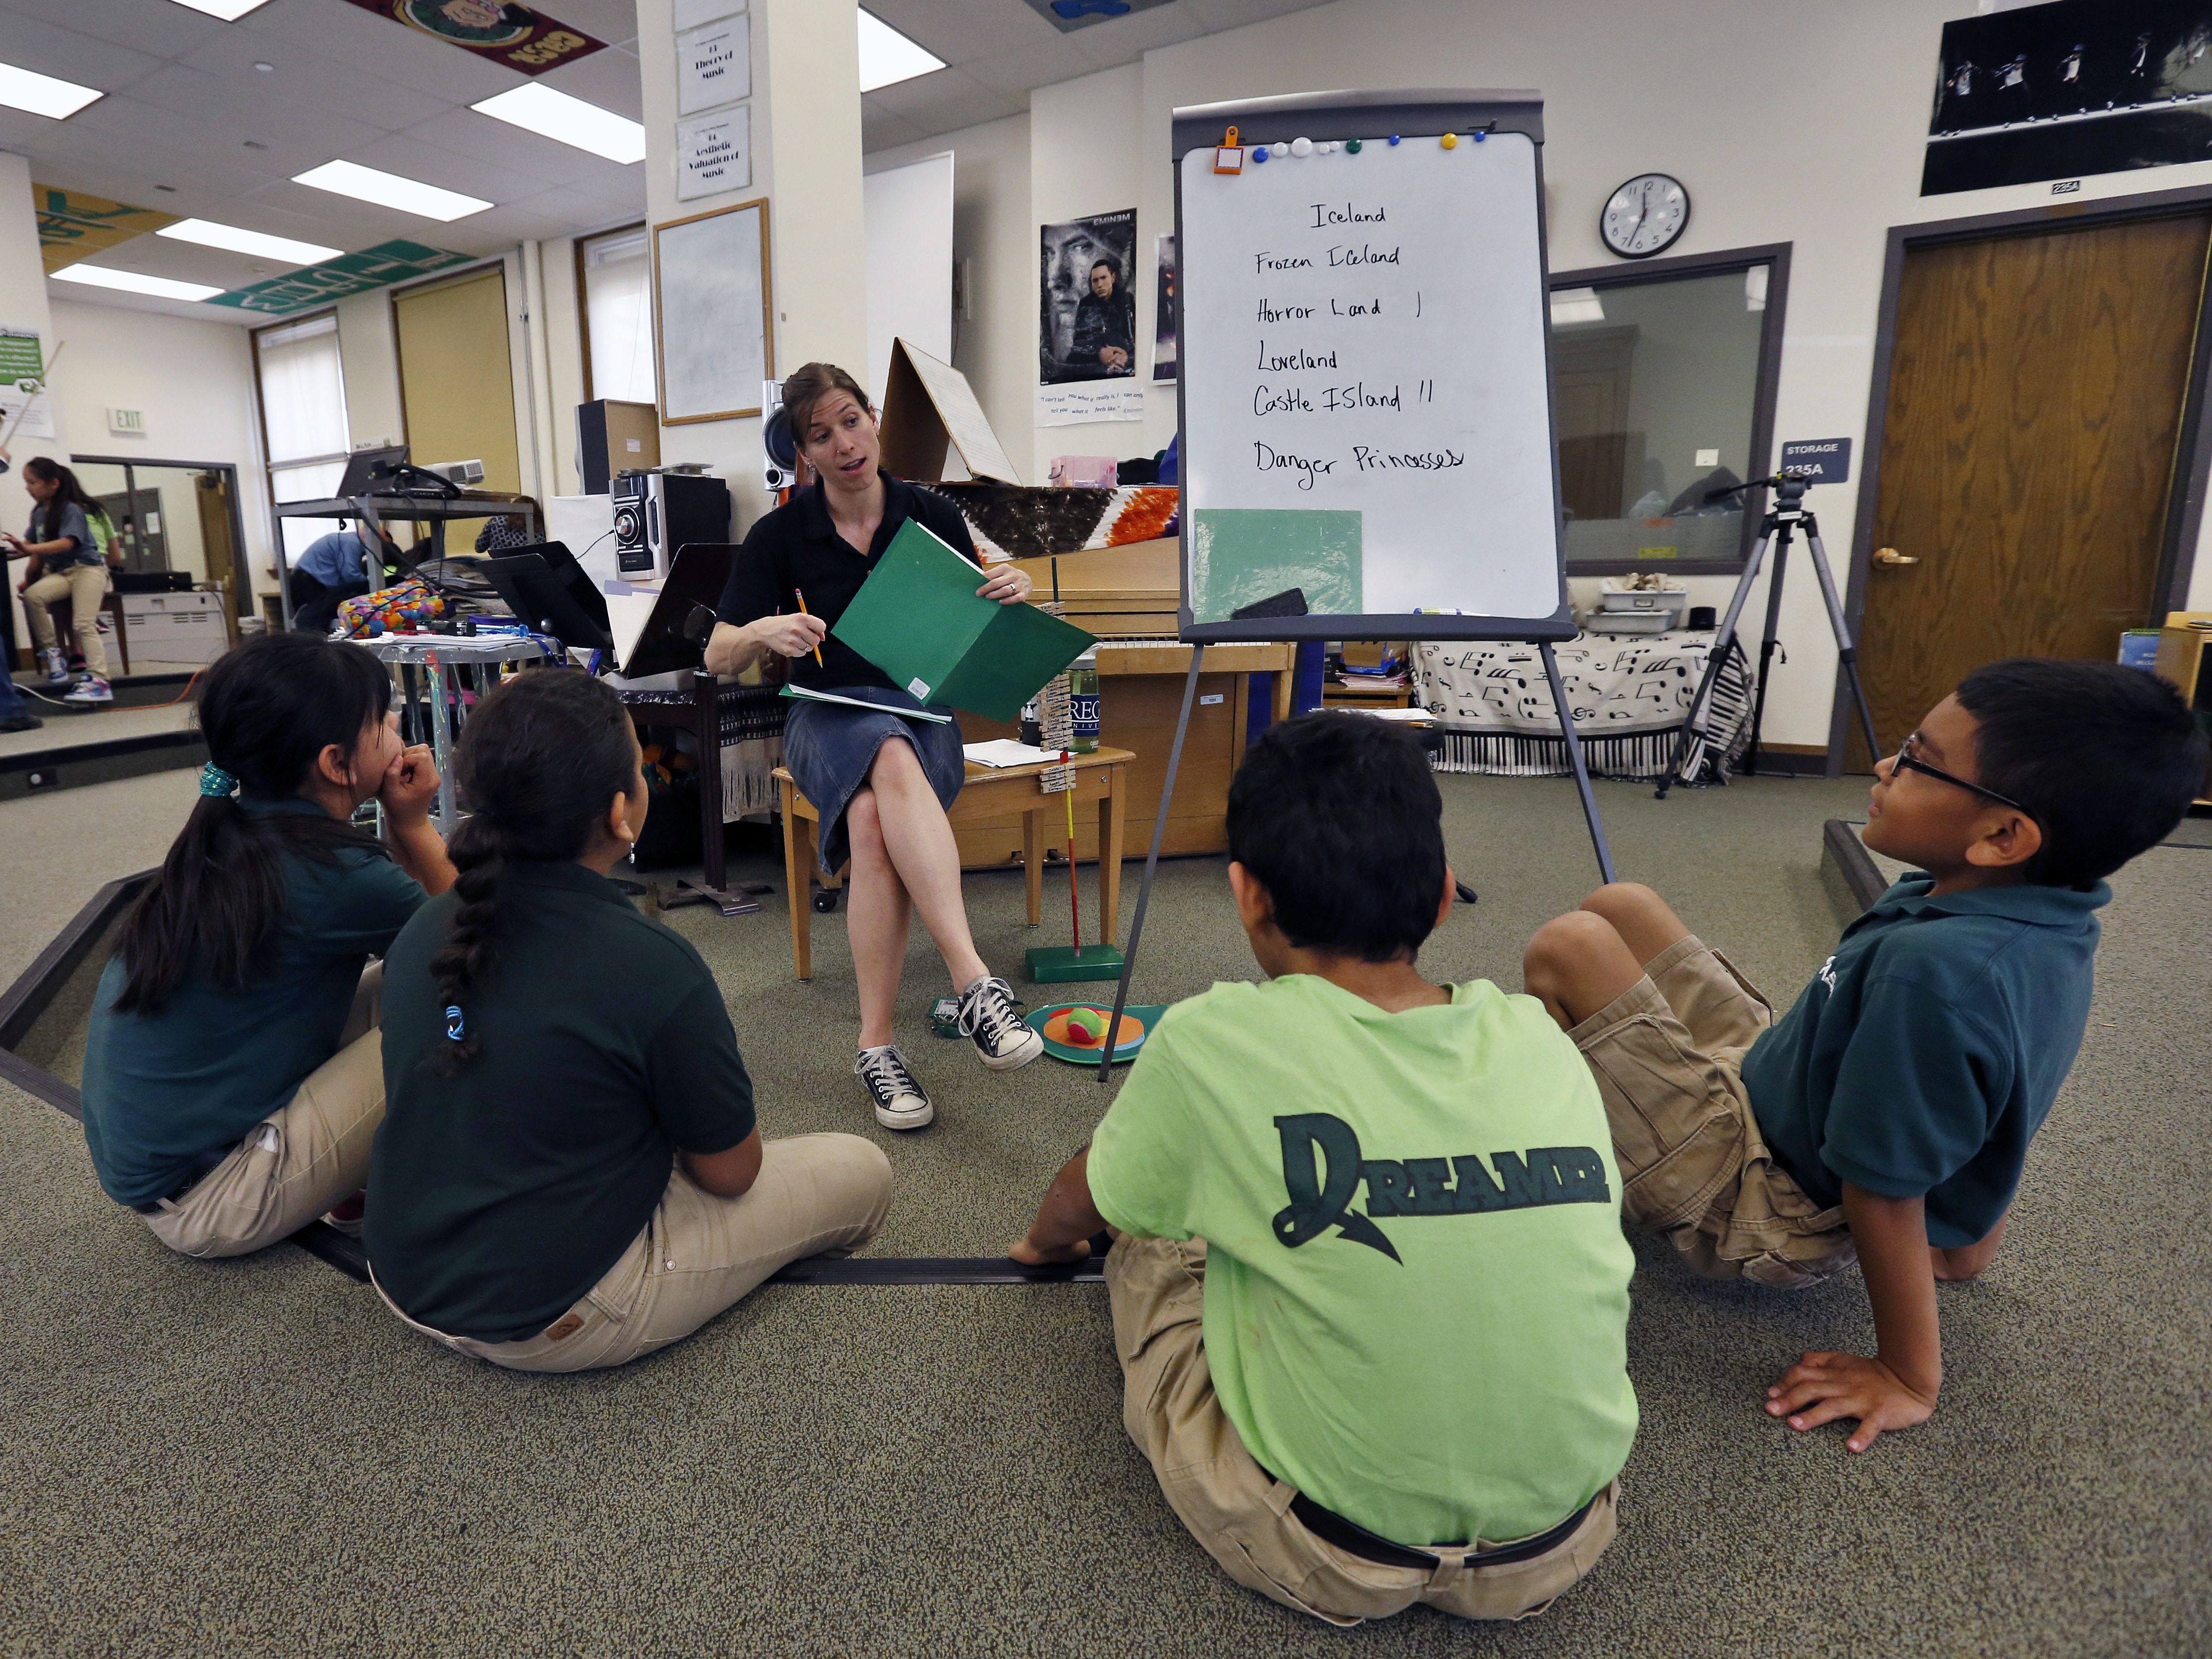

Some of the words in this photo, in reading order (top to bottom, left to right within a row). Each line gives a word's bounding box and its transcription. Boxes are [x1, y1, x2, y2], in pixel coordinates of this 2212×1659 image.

[696, 56, 722, 70] Theory
[724, 50, 732, 60] of
[702, 66, 725, 79] Music
[696, 141, 730, 156] Aesthetic
[689, 155, 729, 170] Valuation
[731, 150, 738, 160] of
[702, 166, 724, 179] Music
[1645, 181, 1654, 190] 12
[2052, 182, 2080, 193] 235A
[1670, 194, 1677, 203] 2
[1311, 203, 1386, 228] Iceland
[1673, 208, 1679, 217] 3
[1622, 237, 1628, 246] 7
[1653, 235, 1659, 244] 5
[1255, 252, 1313, 274] Frozen
[1258, 298, 1315, 323] Horror
[1331, 298, 1381, 317] Land
[1258, 340, 1337, 371] Loveland
[1254, 385, 1314, 416] Castle
[1322, 382, 1401, 412] Island
[115, 410, 140, 428] EXIT
[1787, 443, 1839, 455] STORAGE
[1254, 441, 1337, 491] Danger
[1785, 463, 1824, 476] 235A
